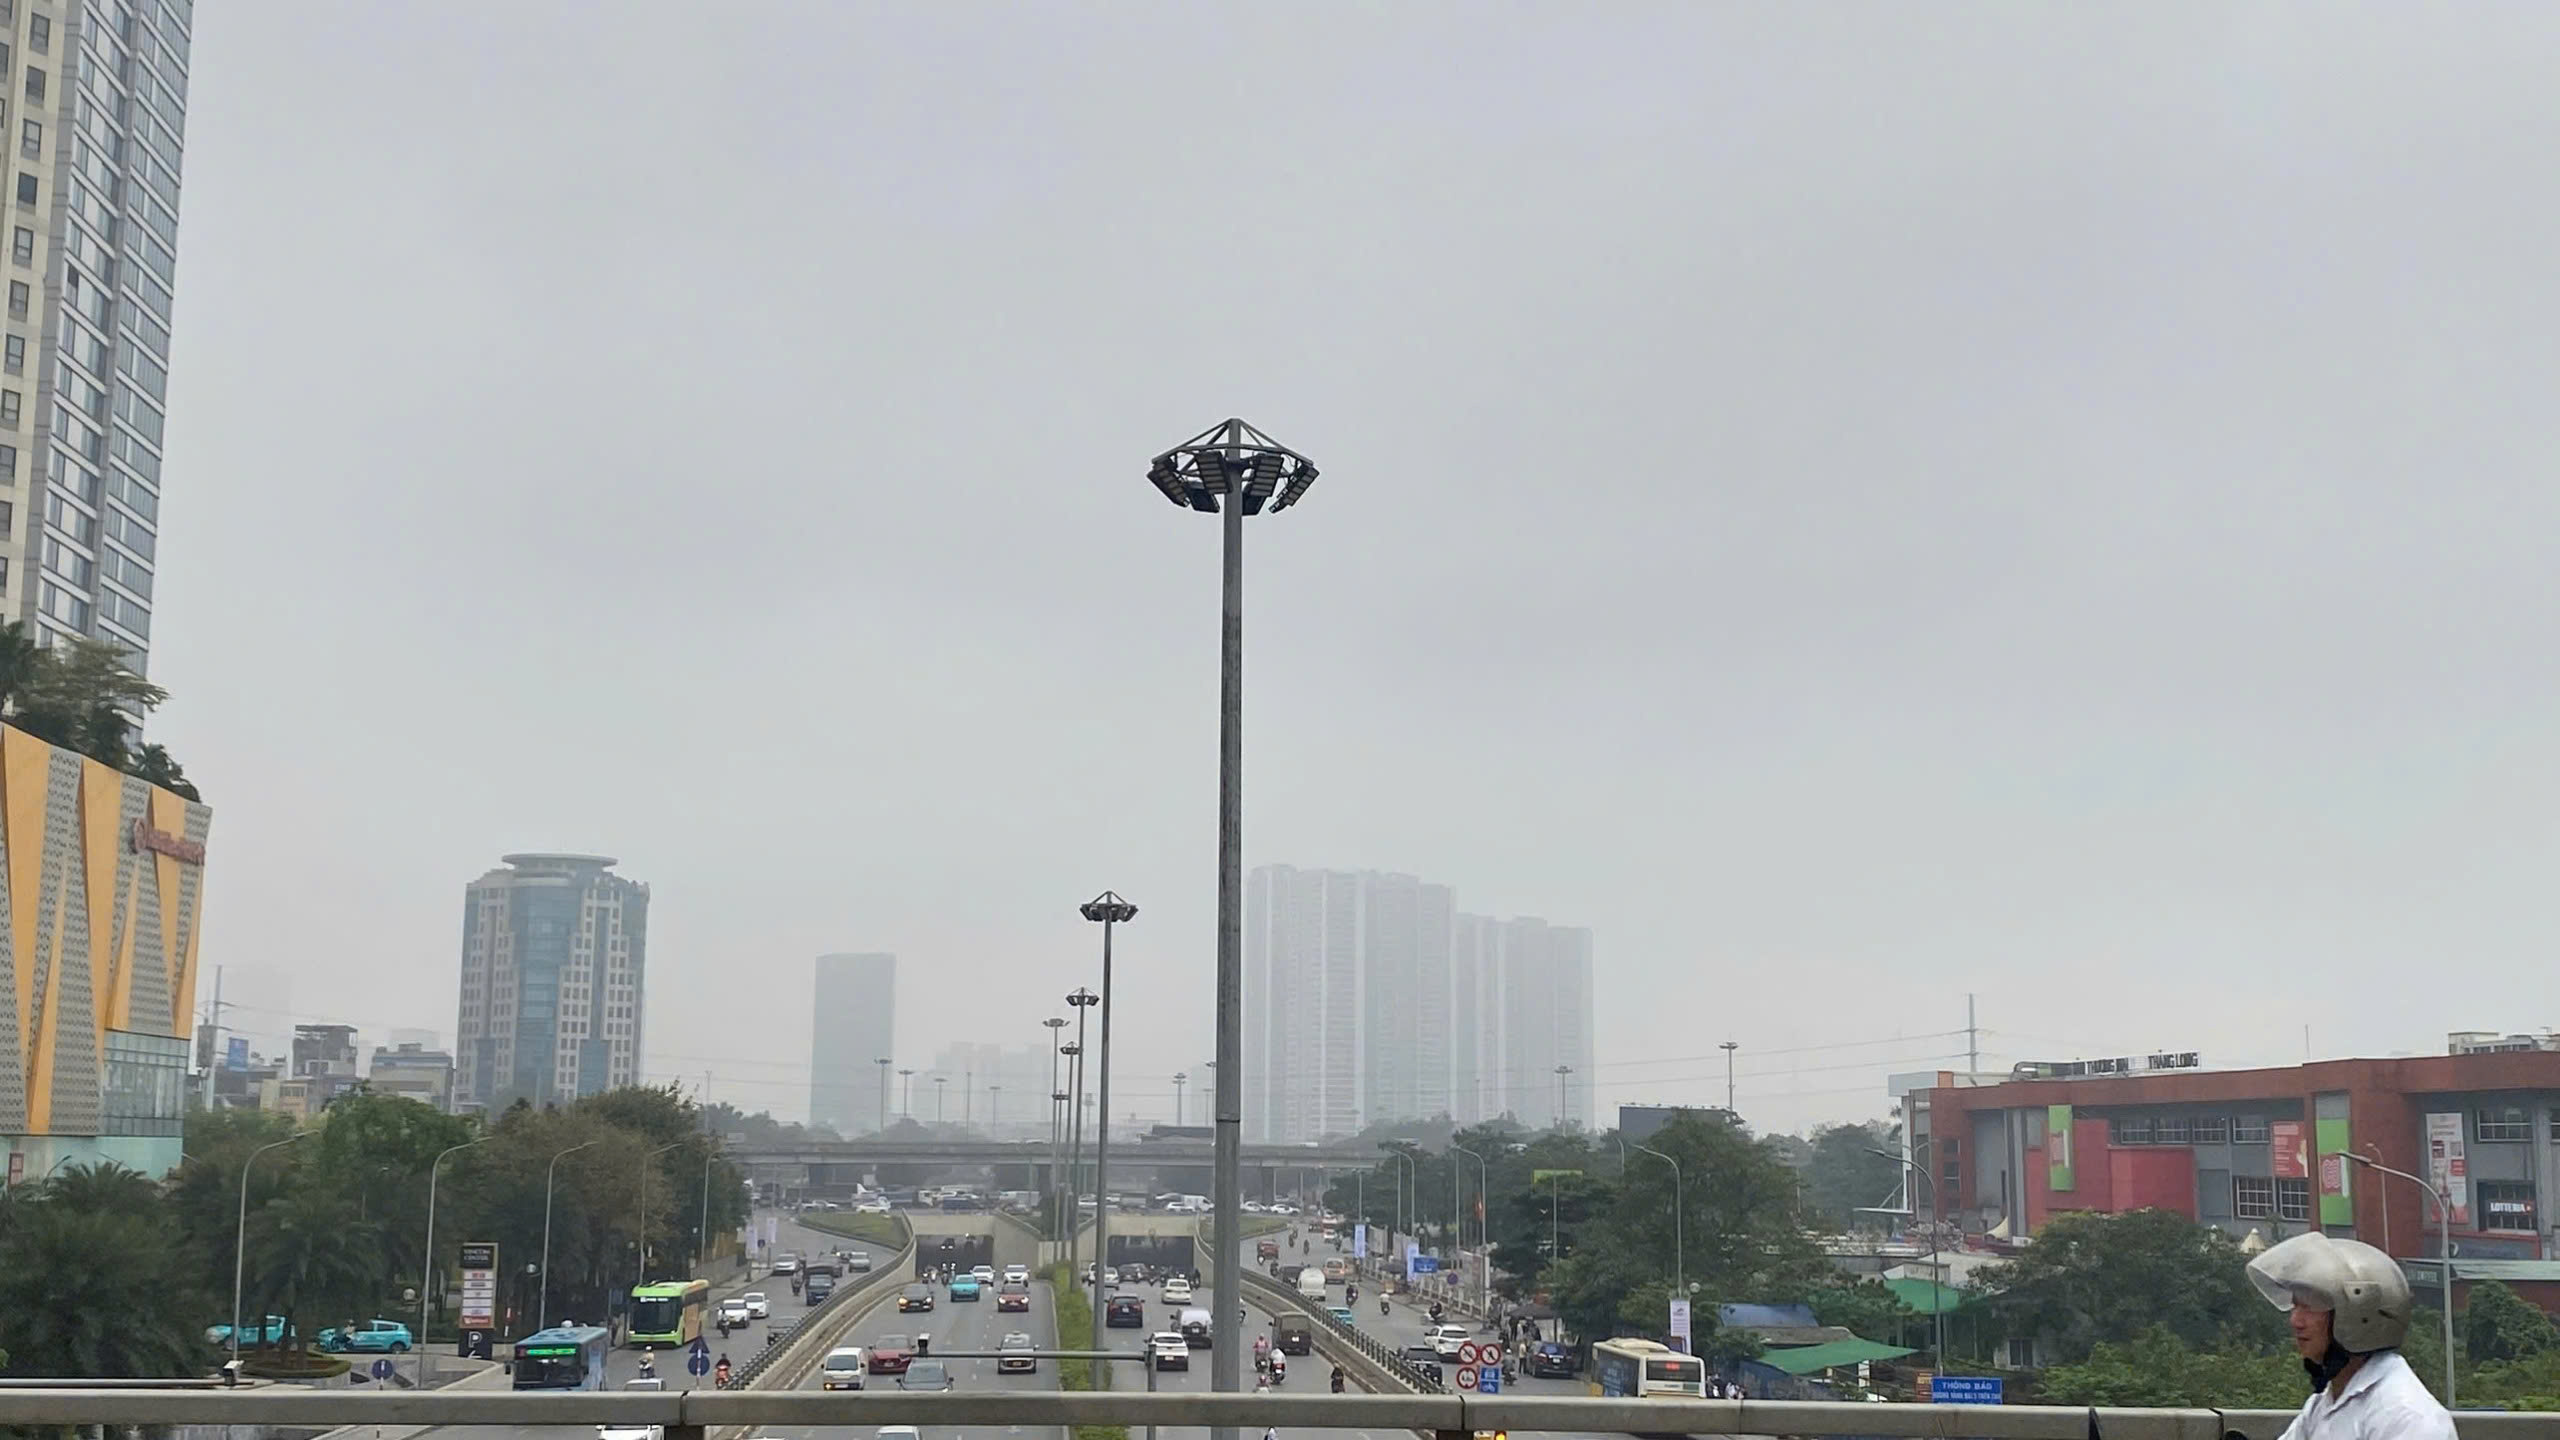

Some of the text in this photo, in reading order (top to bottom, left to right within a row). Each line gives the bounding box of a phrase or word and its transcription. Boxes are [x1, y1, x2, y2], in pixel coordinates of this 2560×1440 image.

[2490, 1202, 2525, 1212] LOTTERIA
[468, 1331, 482, 1349] P
[1943, 1380, 1992, 1390] THÔNG BÁO
